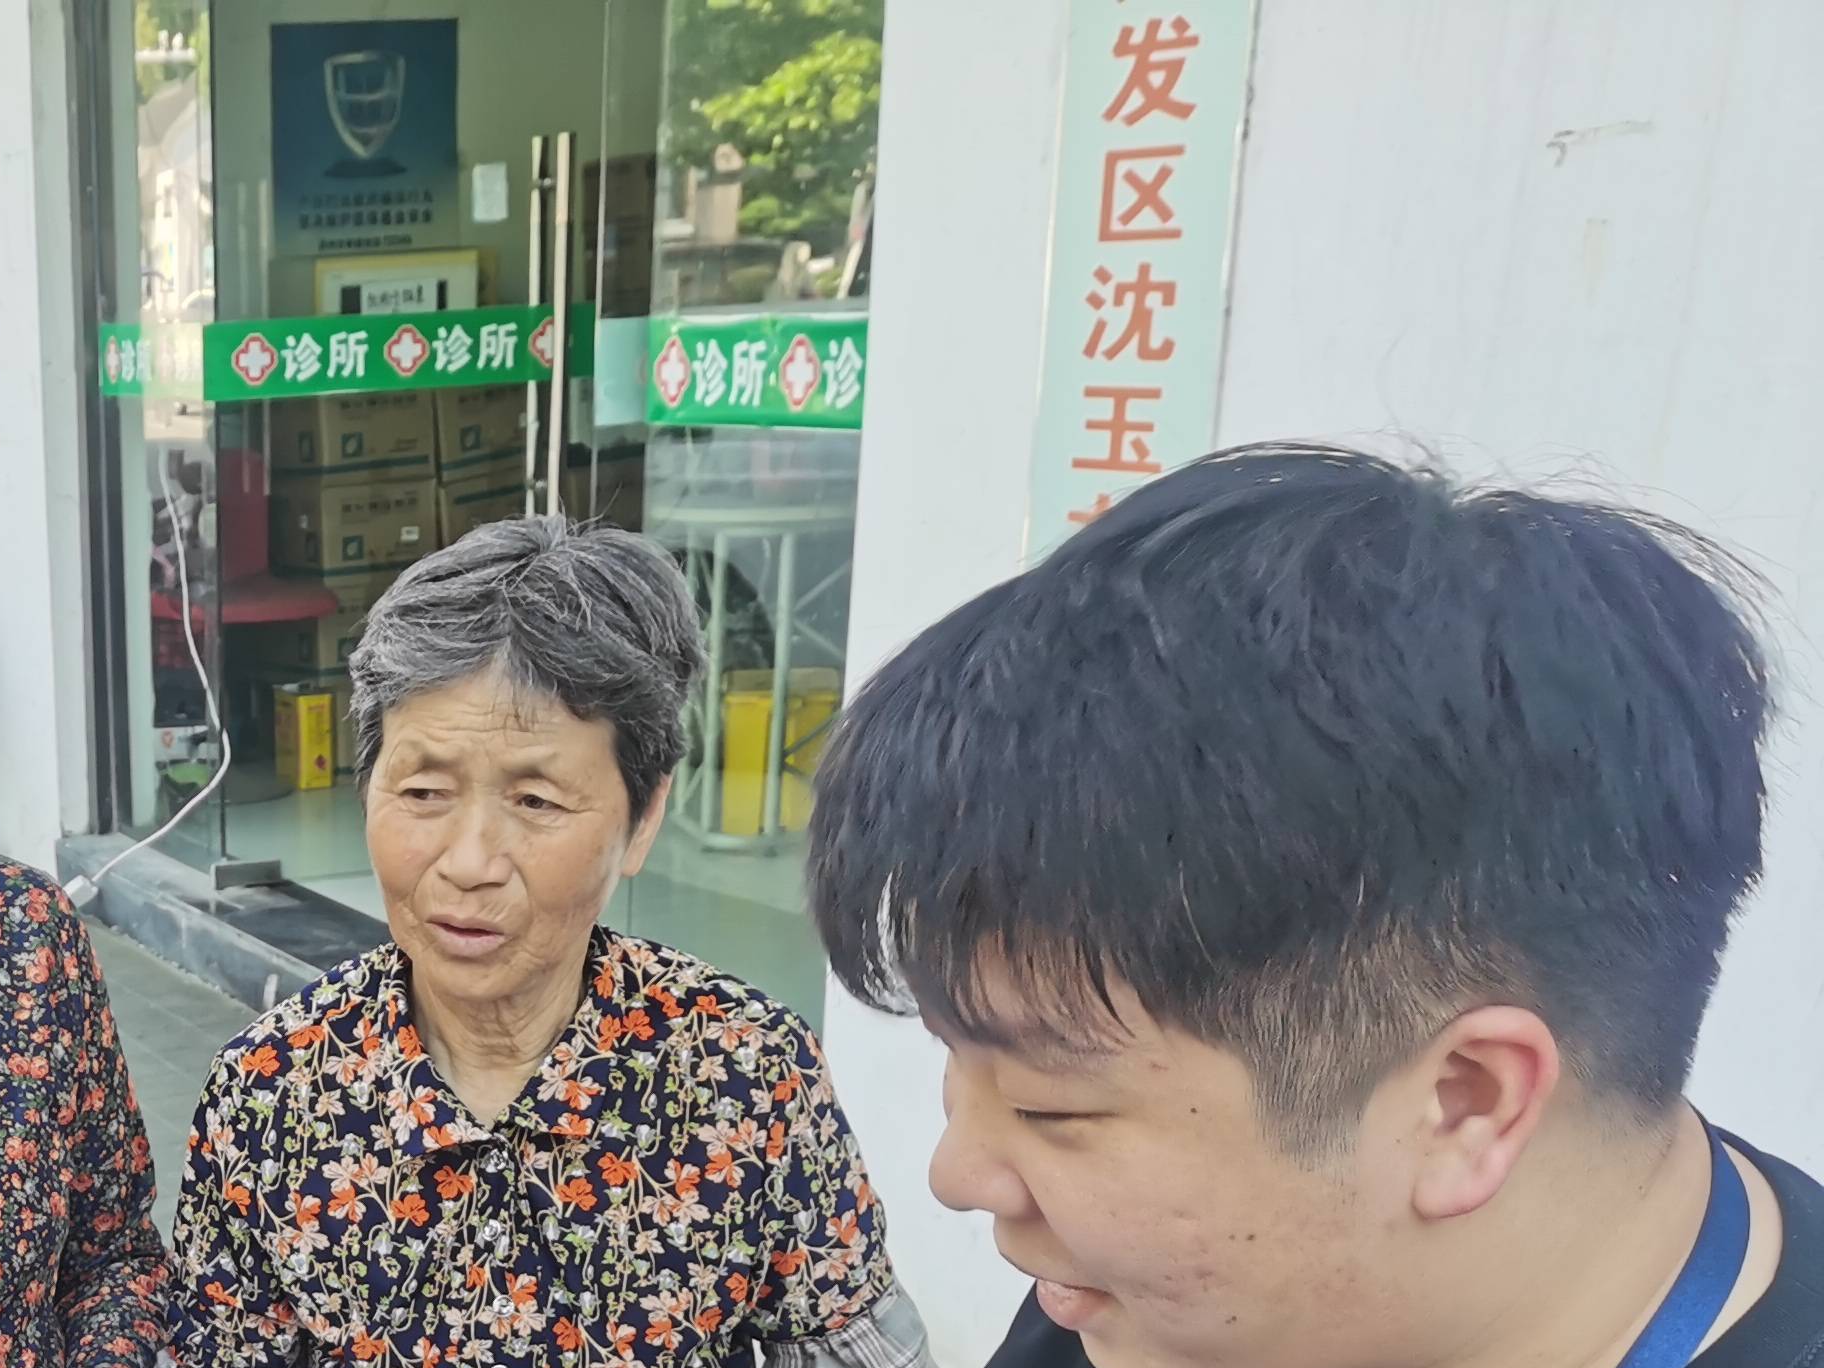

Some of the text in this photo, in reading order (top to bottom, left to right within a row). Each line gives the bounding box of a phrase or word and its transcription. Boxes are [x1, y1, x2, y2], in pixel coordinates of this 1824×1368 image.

[1068, 15, 1200, 523] 发区沈玉
[281, 322, 518, 383] 诊所 诊所
[693, 338, 768, 407] 诊所
